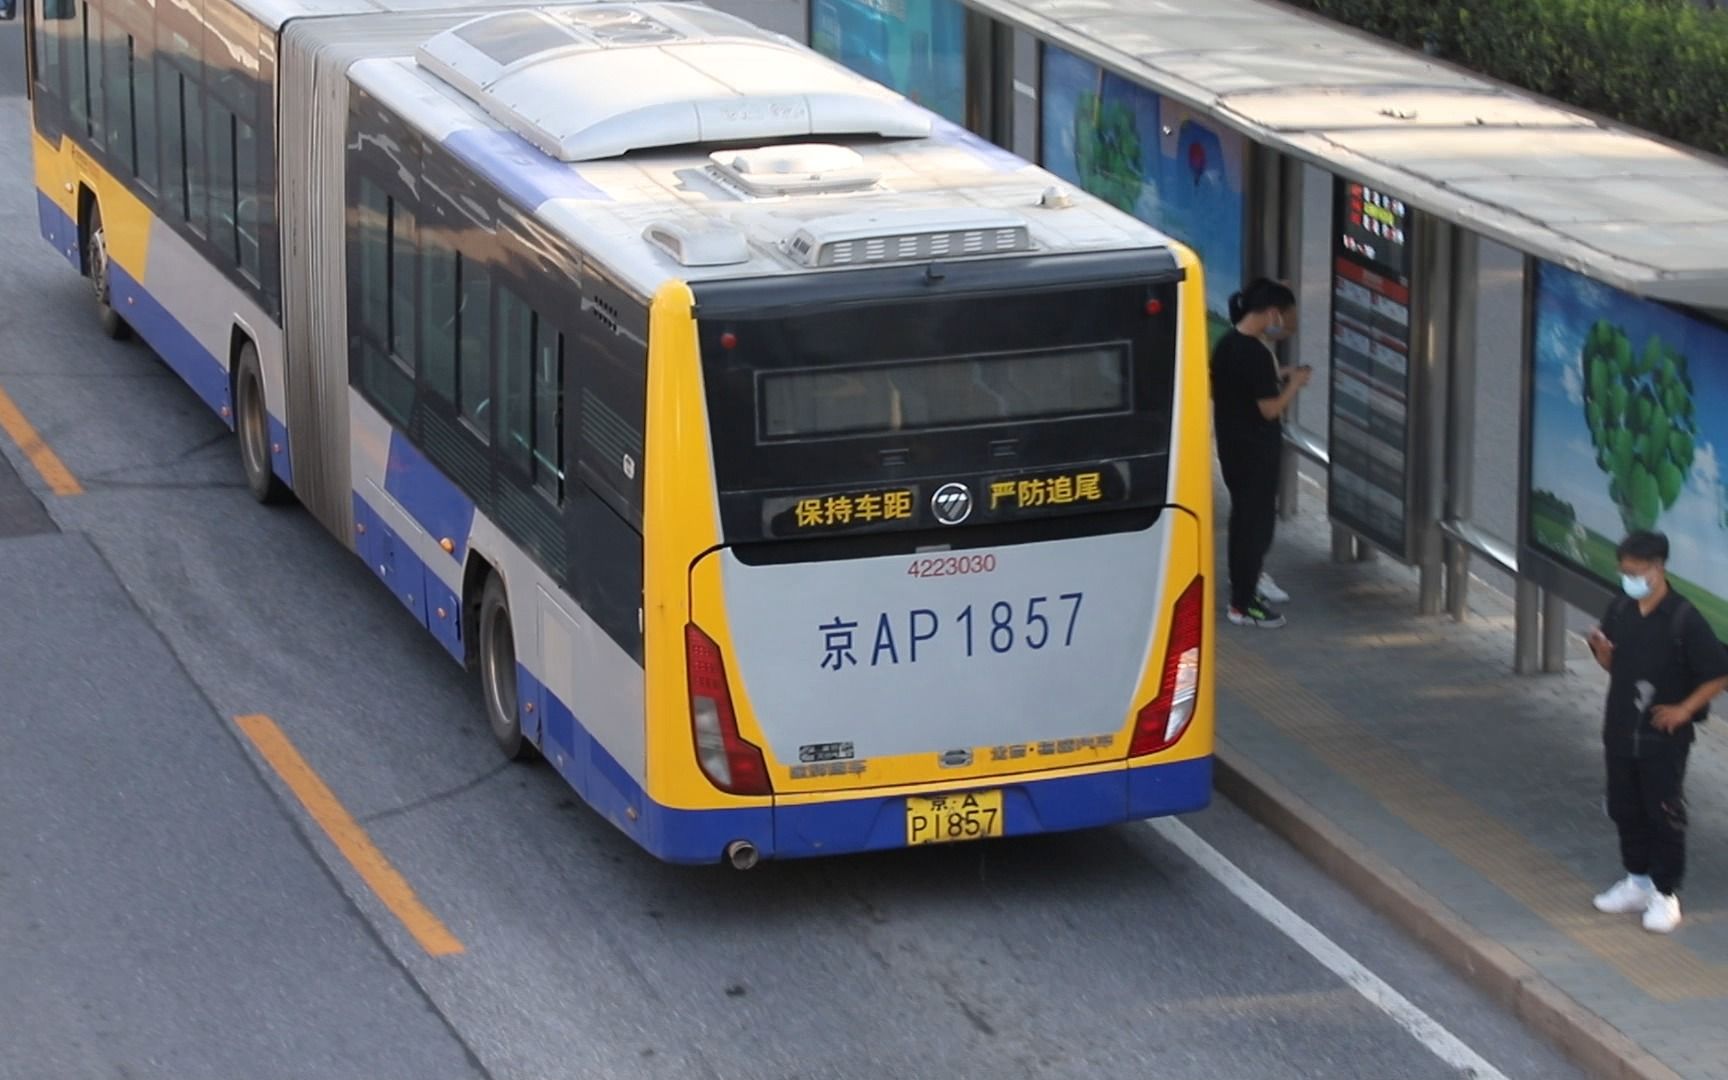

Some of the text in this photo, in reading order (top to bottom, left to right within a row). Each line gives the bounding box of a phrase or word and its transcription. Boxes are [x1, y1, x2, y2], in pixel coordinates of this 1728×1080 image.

[990, 474, 1101, 508] 严防追尾
[796, 492, 911, 525] 保持车距
[907, 555, 996, 578] 4223030
[913, 809, 997, 841] P1857
